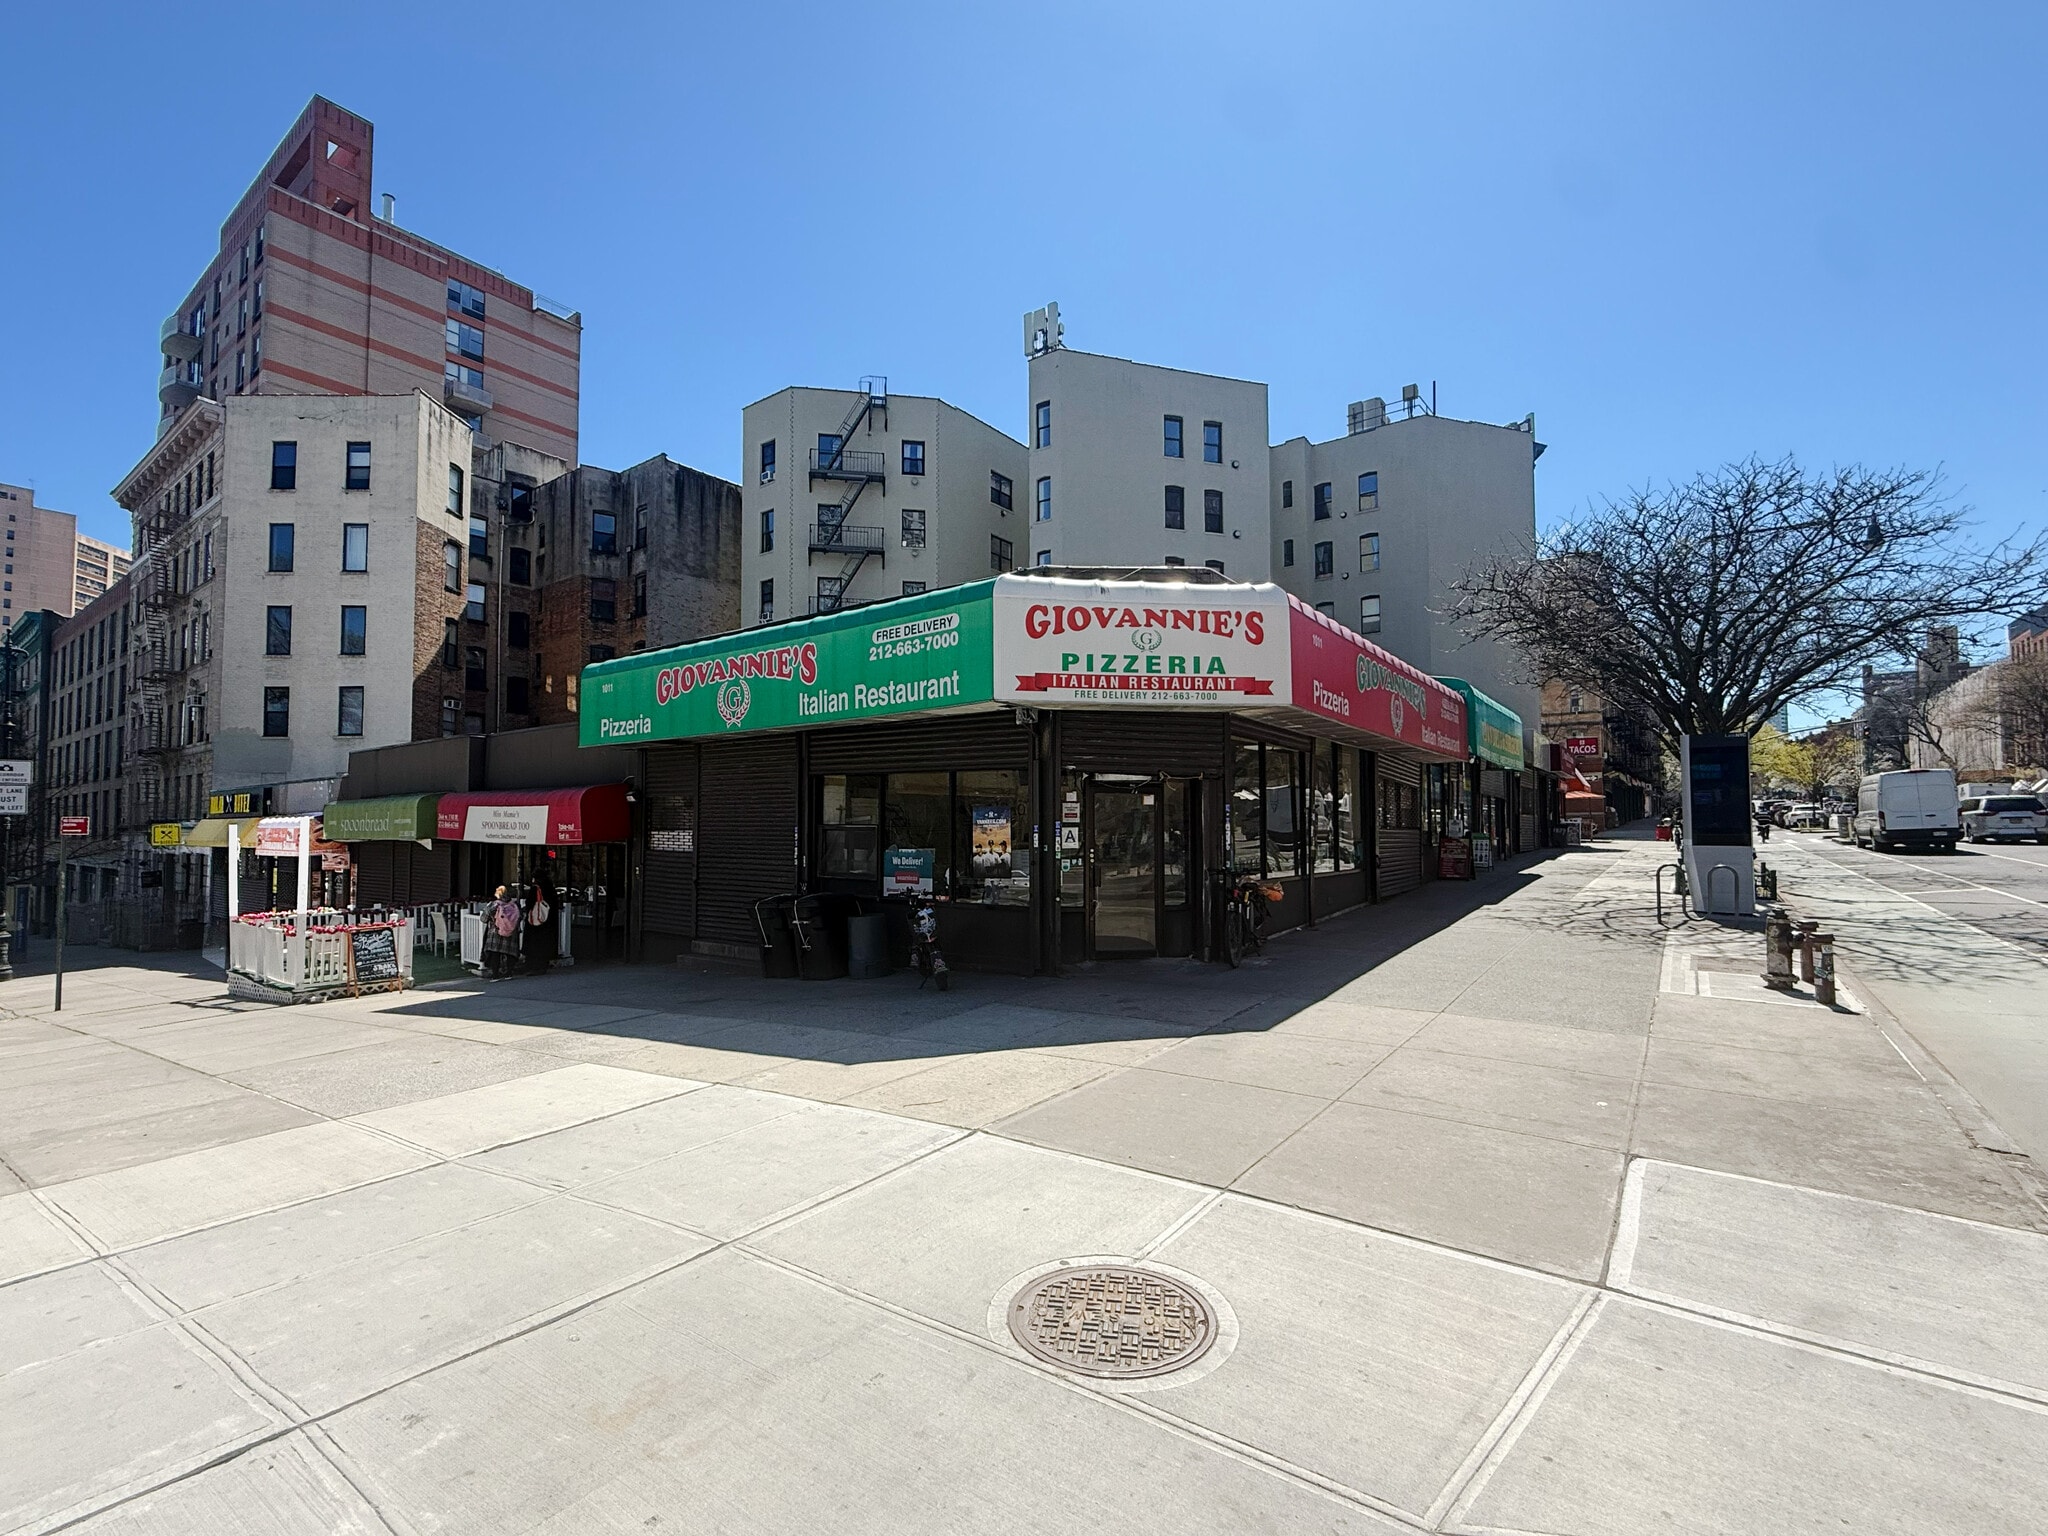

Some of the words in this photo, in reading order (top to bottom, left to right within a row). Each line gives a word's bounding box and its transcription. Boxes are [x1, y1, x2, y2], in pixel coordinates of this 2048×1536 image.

[876, 626, 901, 642] FREE
[903, 616, 954, 637] DELIVERY
[1025, 603, 1265, 646] GIOVANNIE'S
[868, 631, 959, 662] 212-663-7000
[1140, 632, 1153, 645] G
[655, 642, 817, 706] GIOVANNIE'S
[1061, 652, 1226, 675] PIZZERIA
[799, 688, 848, 717] Italian
[854, 671, 960, 711] Restaurant
[1052, 674, 1120, 689] ITALIAN
[1128, 675, 1237, 692] RESTAURANT
[724, 686, 742, 708] G
[1074, 689, 1098, 700] FREE
[1101, 690, 1148, 701] DELIVERY
[1151, 690, 1218, 701] 212-663-7000
[1312, 680, 1350, 717] Pizzeria
[600, 715, 652, 739] Pizzeria
[1569, 745, 1597, 755] TACOS
[340, 811, 390, 838] spoonbread
[481, 820, 516, 831] SPOONBREAD
[517, 820, 530, 831] TOO
[1064, 829, 1076, 843] A
